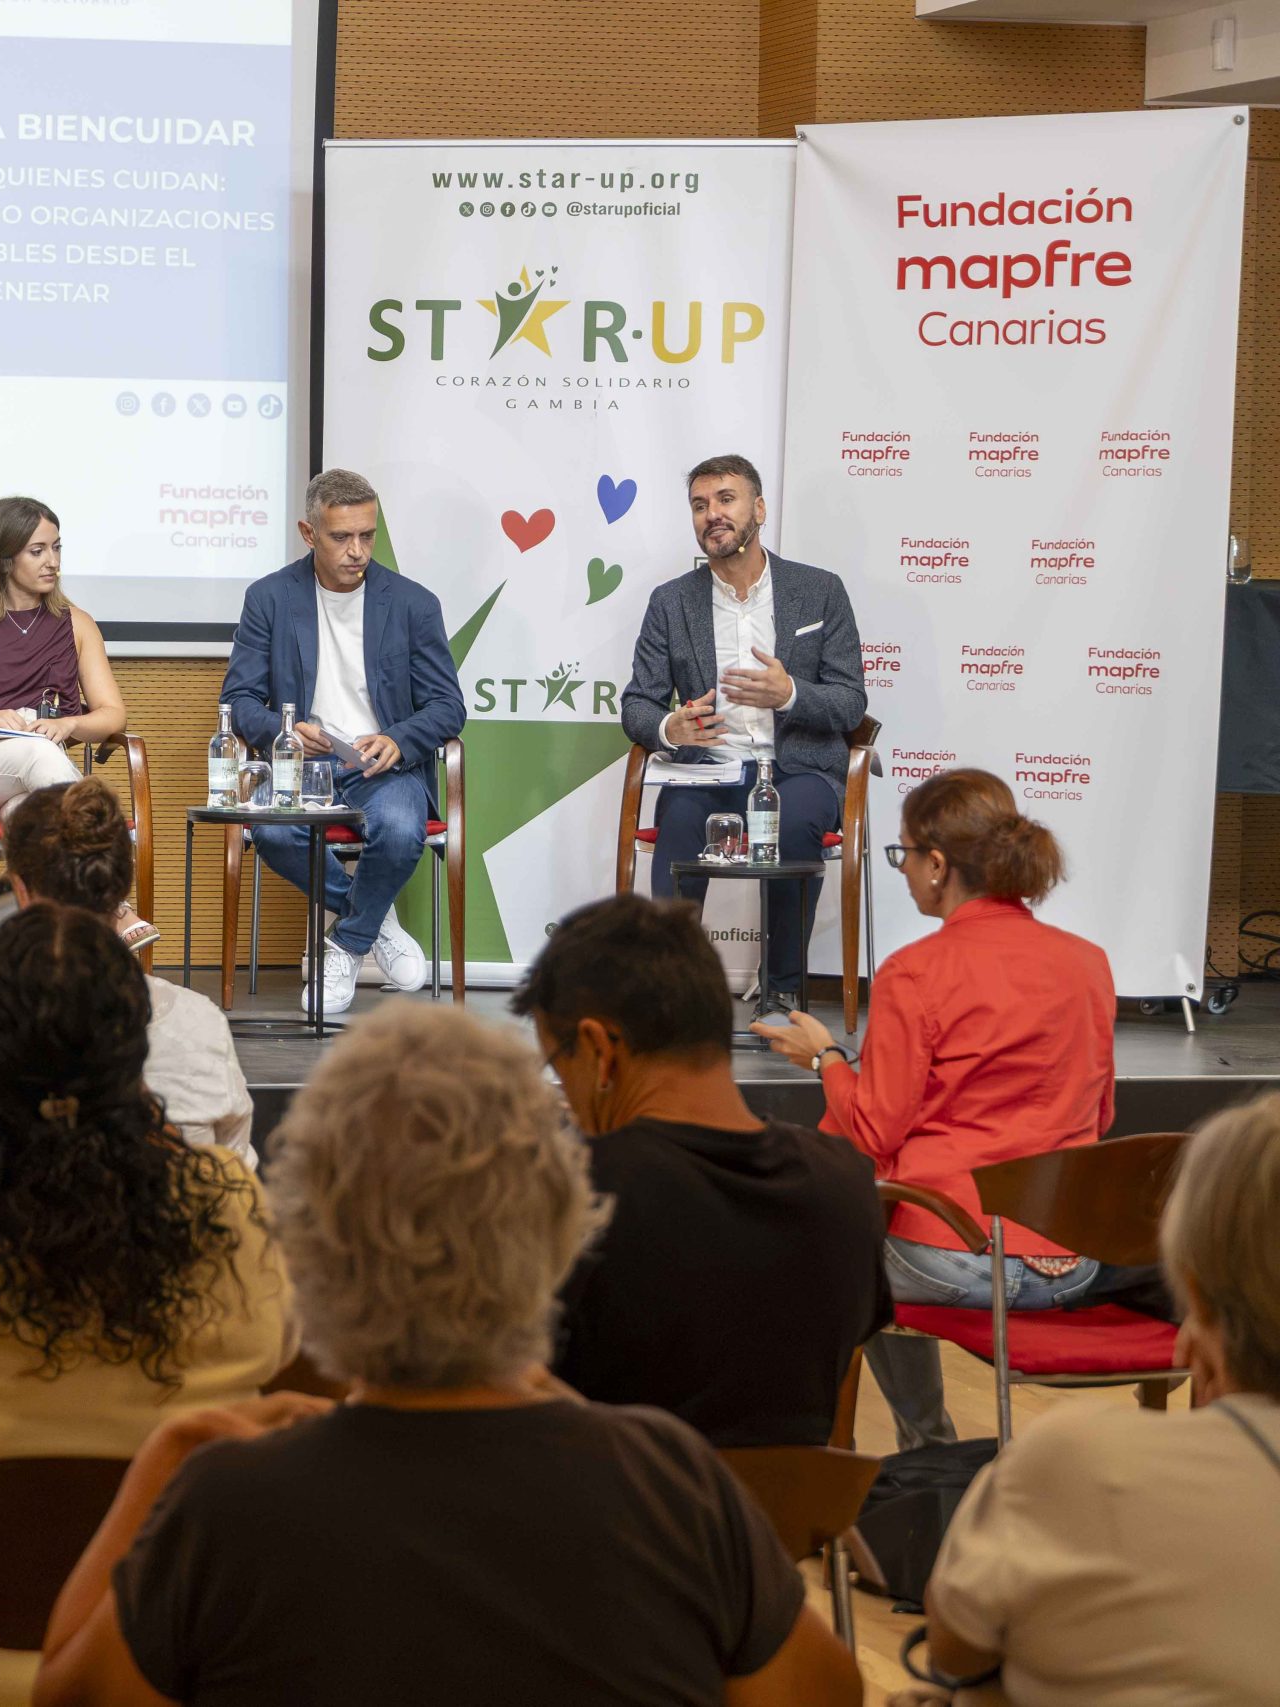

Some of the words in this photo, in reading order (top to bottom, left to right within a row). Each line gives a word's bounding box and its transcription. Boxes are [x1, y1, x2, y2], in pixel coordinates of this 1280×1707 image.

[18, 113, 255, 146] BIENCUIDAR
[113, 169, 225, 191] CUIDAN:
[431, 168, 698, 193] www.star-up.org
[566, 201, 680, 218] @starupoficial
[896, 187, 1132, 228] Fundación
[30, 205, 274, 230] ORGANIZACIONES
[66, 244, 155, 265] DESDE
[165, 247, 196, 266] EL
[896, 239, 1131, 298] mapfre
[918, 309, 1106, 346] Canarias
[435, 375, 545, 386] CORAZÓN
[562, 376, 689, 388] SOLIDARIO
[505, 398, 618, 409] GAMBIA
[842, 431, 910, 441] Fundación
[969, 431, 1038, 442] Fundación
[1100, 429, 1170, 441] Fundación
[841, 445, 909, 462] mapfre
[968, 446, 1038, 463] mapfre
[1098, 444, 1169, 462] mapfre
[847, 464, 902, 476] Canarias
[974, 465, 1031, 477] Canarias
[1102, 465, 1162, 476] Canarias
[160, 483, 268, 500] Fundación
[159, 503, 268, 528] mapfre
[170, 531, 258, 548] Canarias
[901, 537, 969, 548] Fundación
[1031, 539, 1094, 550] Fundación
[900, 552, 968, 569] mapfre
[1030, 553, 1094, 570] mapfre
[906, 571, 961, 583] Canarias
[1035, 573, 1086, 584] Canarias
[859, 641, 902, 654] dación
[961, 645, 1024, 656] Fundación
[1088, 647, 1160, 659] Fundación
[863, 655, 902, 674] pfre
[960, 659, 1023, 677] mapfre
[1088, 663, 1159, 680] mapfre
[864, 675, 896, 689] arias
[966, 679, 1015, 690] Canarias
[1095, 682, 1152, 695] Canarias
[892, 748, 956, 760] Fundación
[1015, 752, 1090, 765] Fundación
[891, 764, 946, 780] mapf
[1015, 768, 1090, 785] mapfre
[1023, 787, 1082, 800] Canarias
